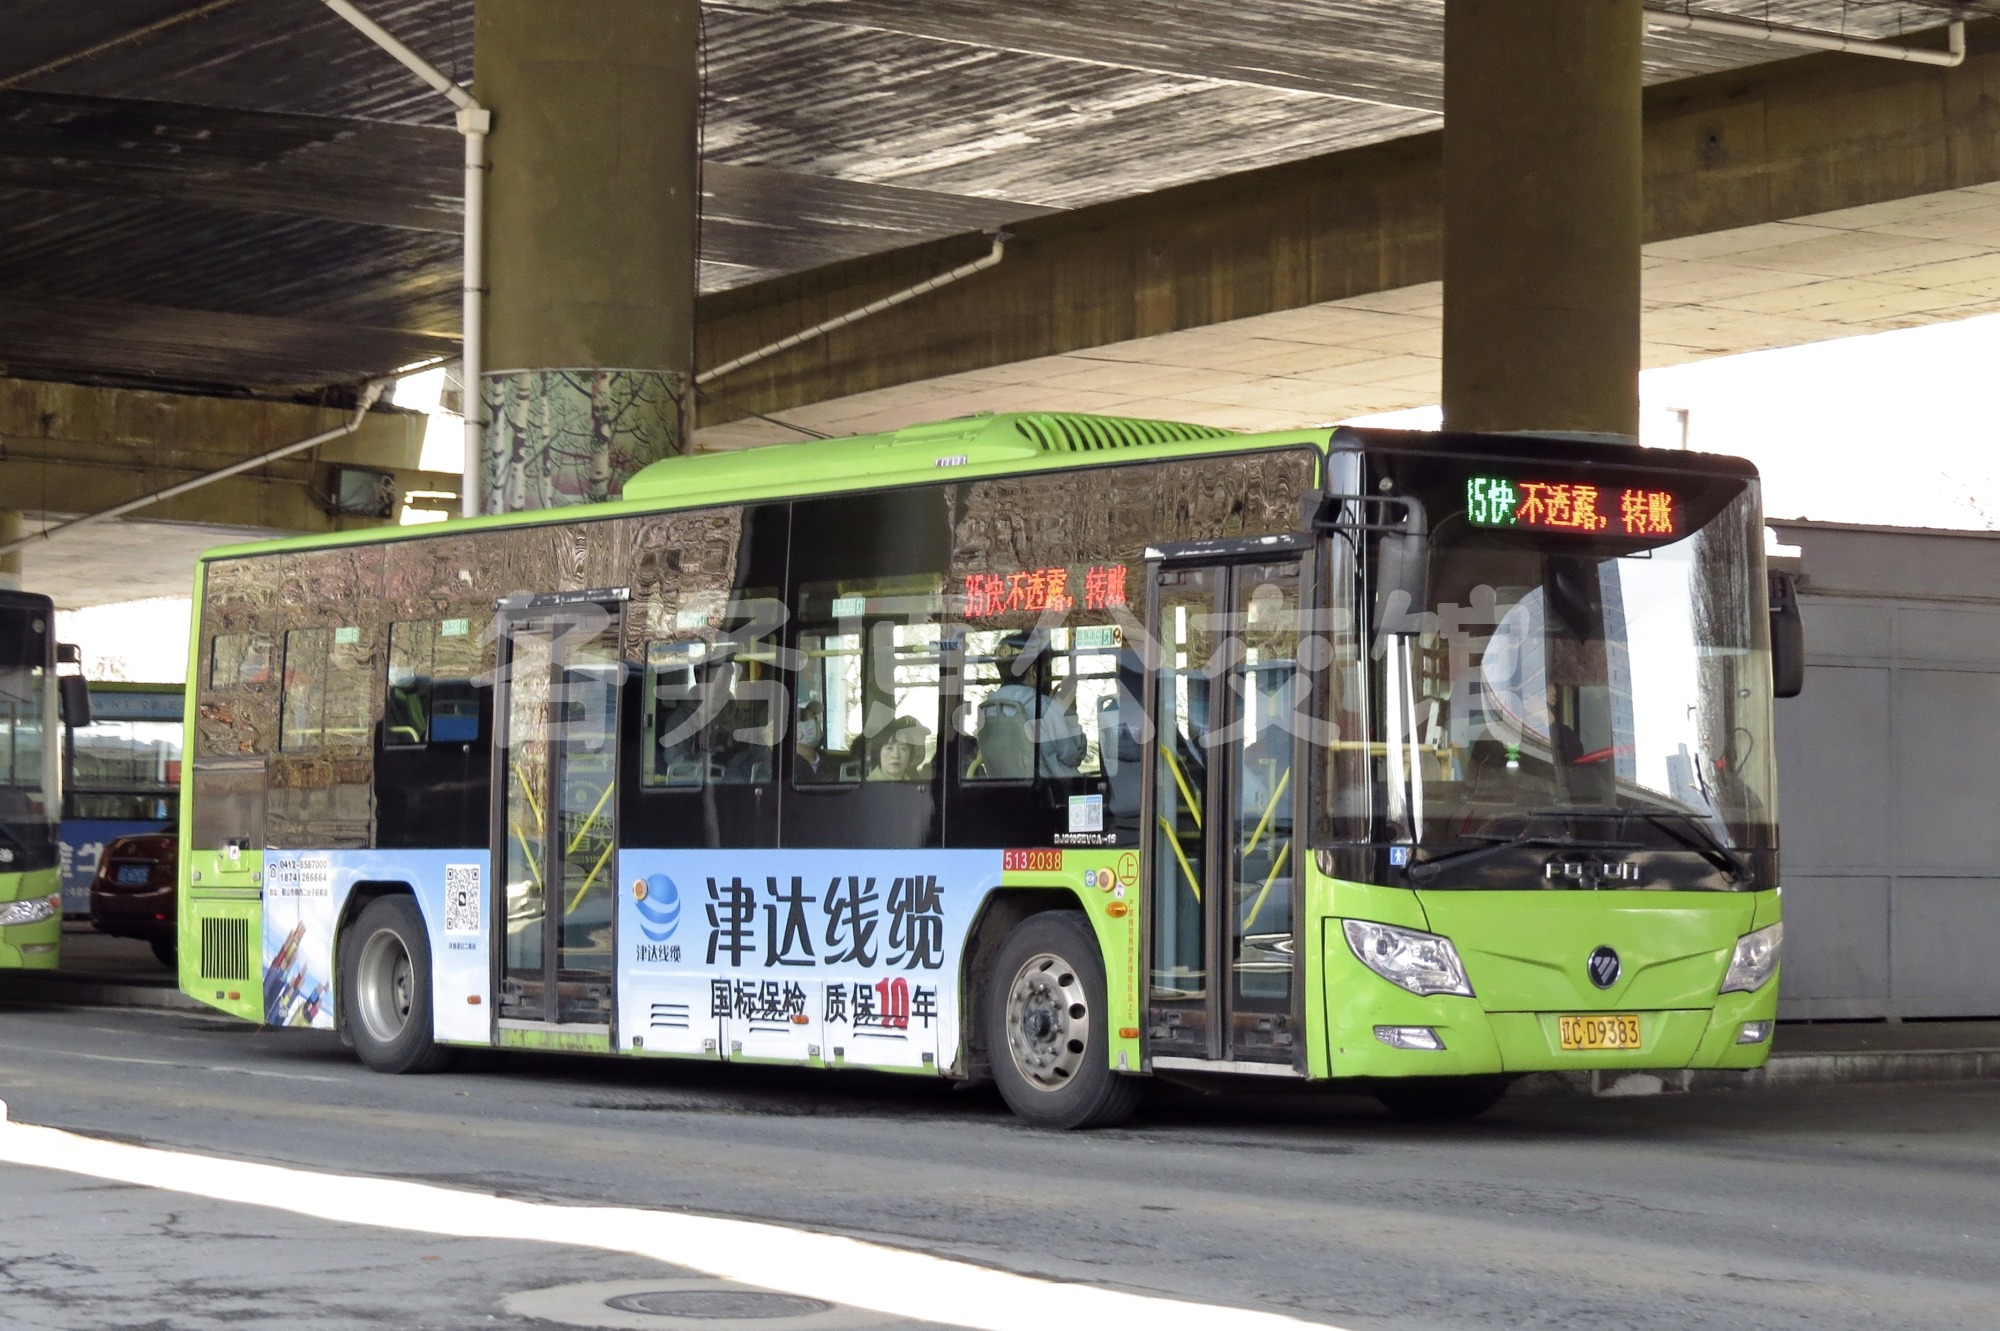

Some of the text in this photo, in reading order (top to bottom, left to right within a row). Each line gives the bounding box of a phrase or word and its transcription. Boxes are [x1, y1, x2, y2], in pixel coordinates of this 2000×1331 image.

[1005, 851, 1062, 870] 5132038
[1120, 856, 1136, 880] 上
[1545, 862, 1639, 880] FOON
[705, 875, 945, 969] 津达线缆
[636, 944, 682, 963] 津达线缆
[711, 977, 938, 1030] 国标保检 质保10年
[1561, 1020, 1639, 1045] 辽C·D9383
